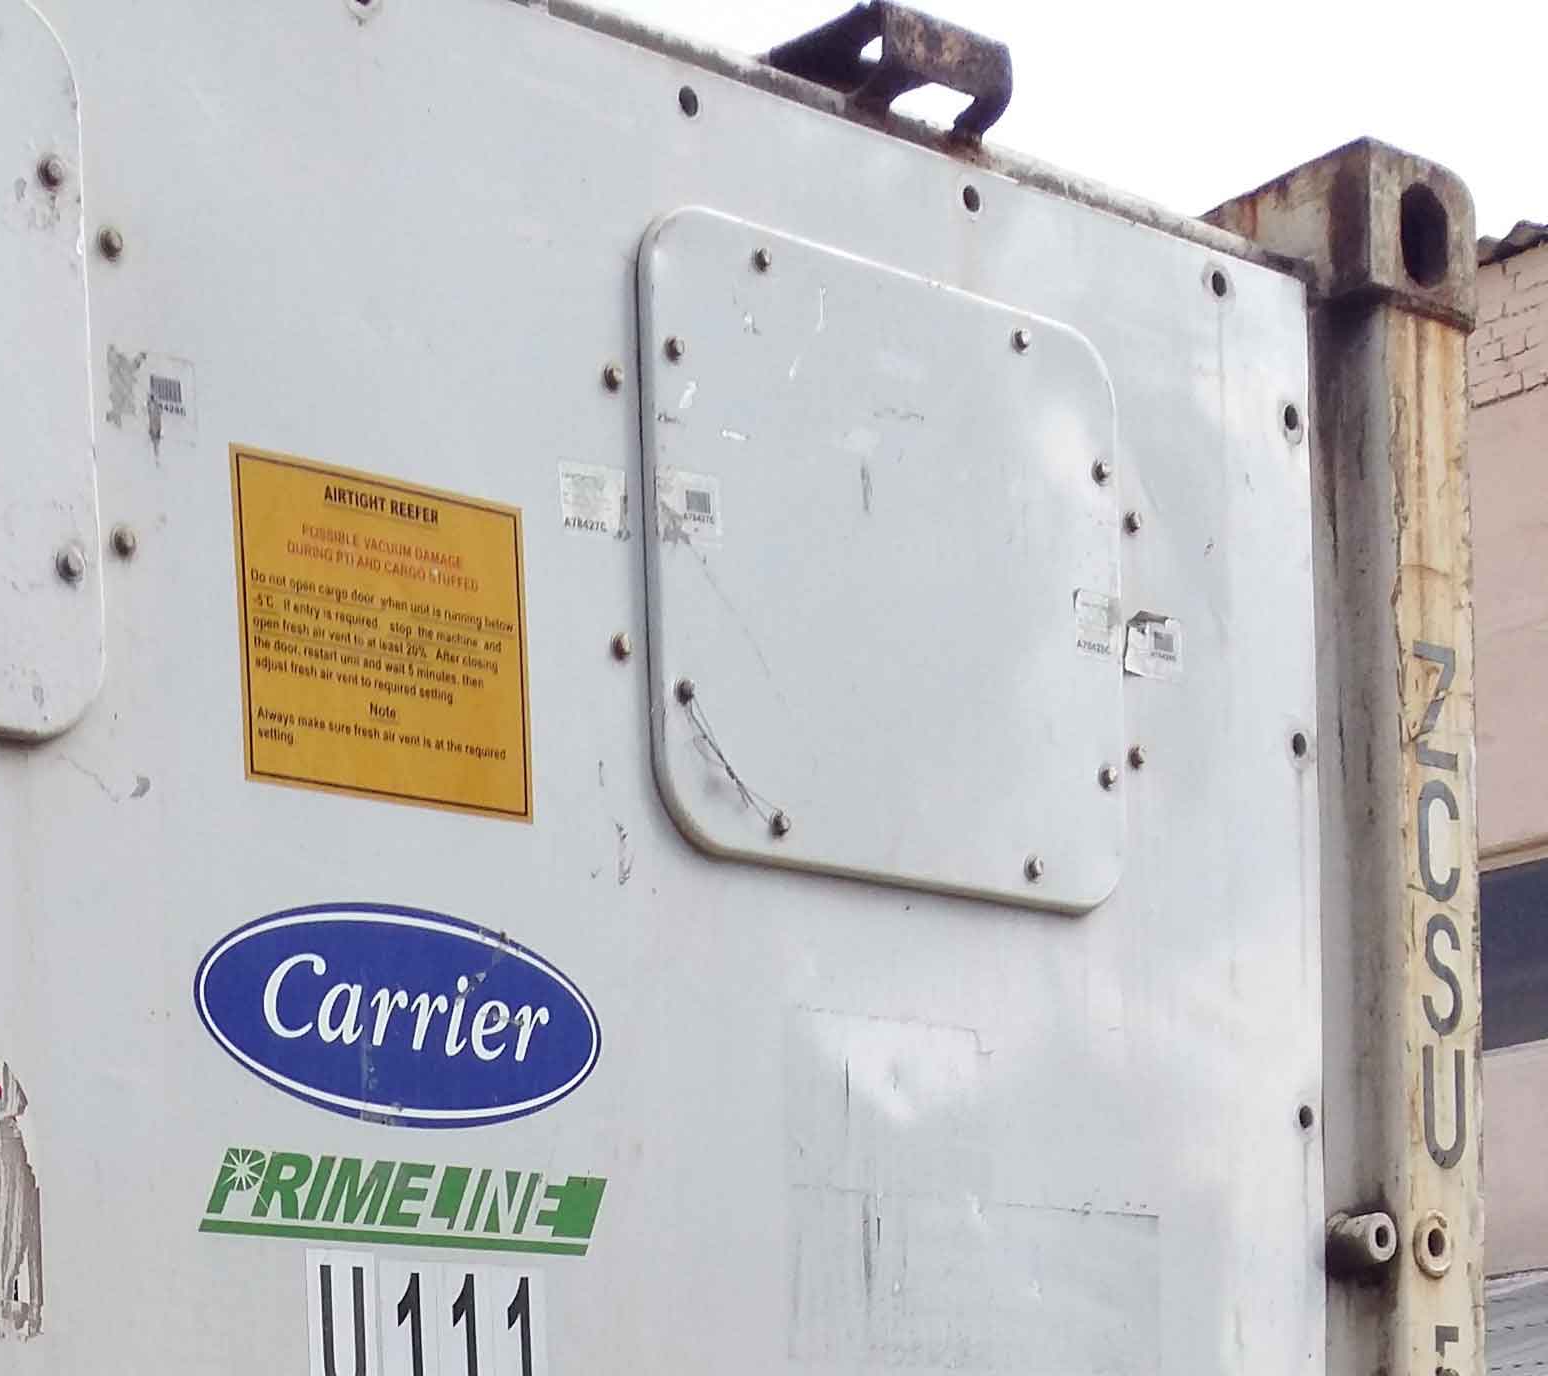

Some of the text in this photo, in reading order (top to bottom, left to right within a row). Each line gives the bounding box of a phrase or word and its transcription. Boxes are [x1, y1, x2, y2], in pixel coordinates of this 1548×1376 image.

[324, 484, 439, 524] AIRTIGHT REEFER
[287, 541, 333, 562] DURING
[356, 554, 382, 571] AND
[384, 560, 426, 582] CARGO
[428, 569, 479, 592] STUFFED
[302, 523, 462, 569] POSSIBLE VACUUM DAMAGE
[251, 567, 267, 583] Do
[269, 572, 287, 588] not
[289, 577, 316, 595] open
[318, 583, 348, 602] cargo
[380, 596, 408, 614] when
[410, 601, 430, 615] unit
[432, 605, 442, 618] is
[444, 608, 482, 630] running
[484, 616, 514, 633] below
[253, 616, 280, 632] open
[282, 619, 310, 636] fresh
[312, 625, 326, 639] air
[328, 629, 352, 645] vent
[353, 634, 365, 646] to
[367, 637, 376, 648] at
[379, 639, 404, 655] least
[435, 651, 460, 665] After
[462, 655, 499, 674] closing
[292, 602, 321, 620] entry
[323, 606, 333, 619] is
[389, 621, 412, 637] stop
[418, 623, 434, 638] the
[436, 629, 479, 647] machine
[483, 639, 502, 653] and
[253, 636, 271, 649] the
[303, 646, 338, 662] restart
[340, 653, 360, 666] unit
[363, 657, 382, 671] and
[385, 662, 406, 675] wait
[461, 676, 485, 689] then
[255, 658, 288, 675] adjust
[290, 663, 317, 679] fresh
[319, 668, 333, 681] air
[336, 673, 359, 686] vent
[360, 676, 372, 688] to
[374, 680, 416, 698] required
[257, 706, 506, 761] Always make sure fresh air vent is at the required
[1412, 639, 1466, 1169] ZCSU
[263, 953, 550, 1062] Carrier
[206, 1147, 607, 1239] PRIMELINE
